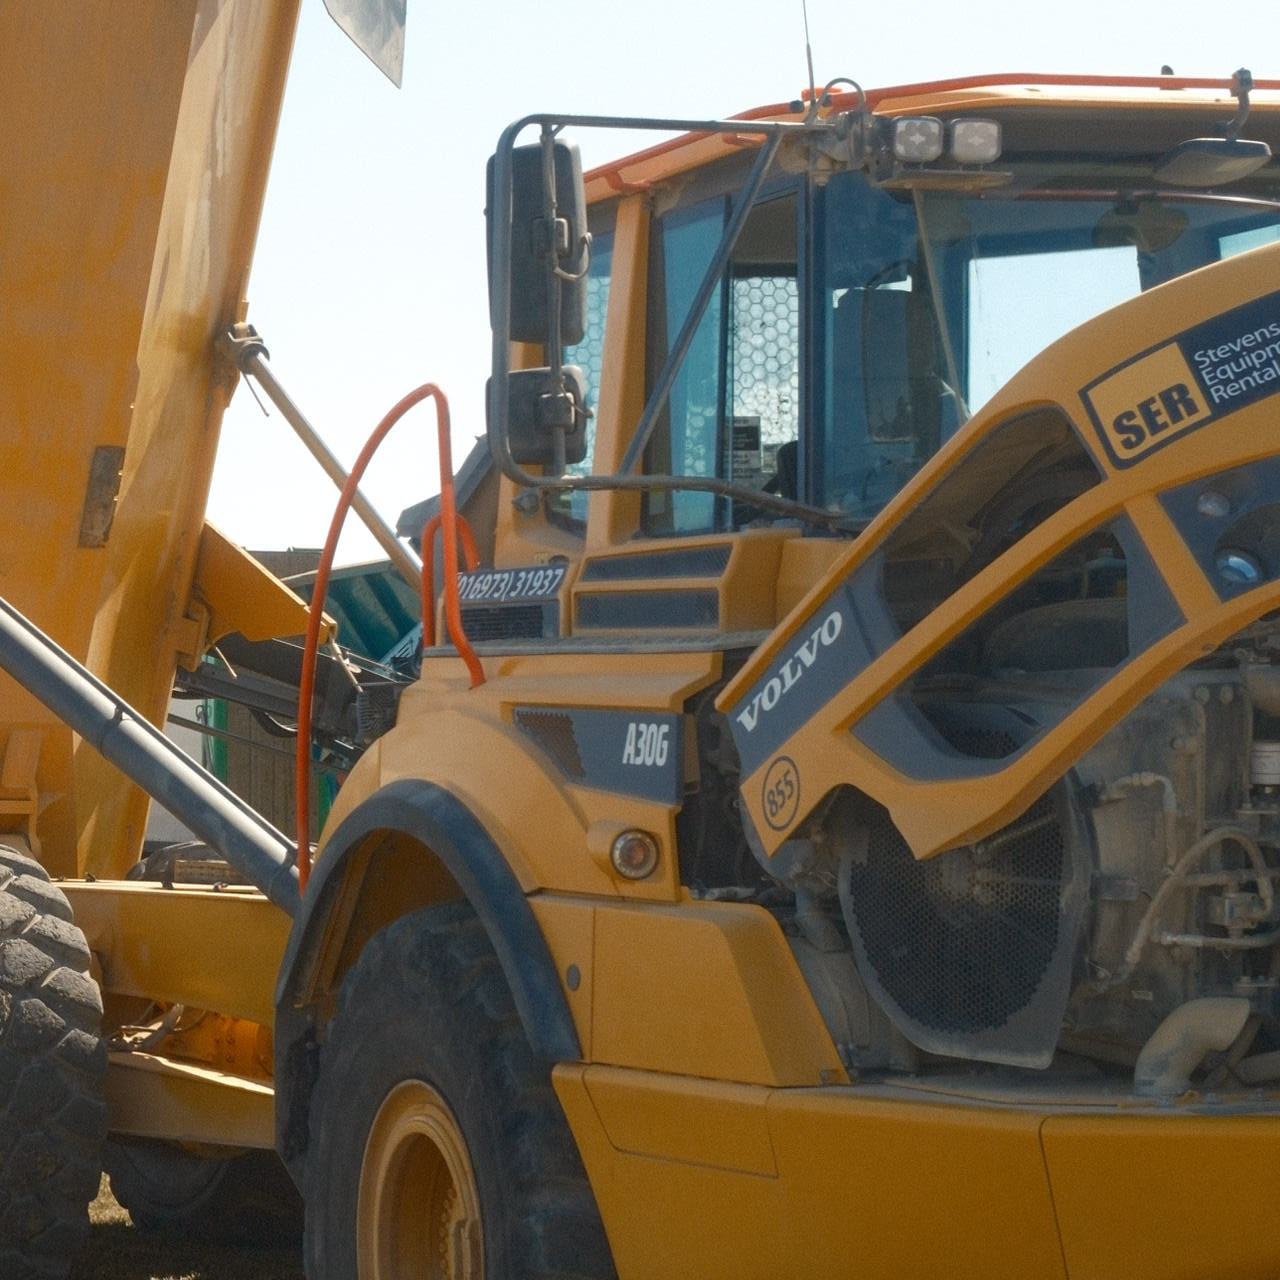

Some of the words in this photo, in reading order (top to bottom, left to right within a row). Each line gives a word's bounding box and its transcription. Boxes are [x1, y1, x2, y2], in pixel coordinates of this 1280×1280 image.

[1194, 323, 1280, 369] Stevens
[1210, 359, 1280, 404] Rental
[1112, 382, 1200, 451] SER
[509, 568, 564, 598] 31937
[736, 610, 843, 733] VOLVO
[622, 722, 670, 767] A30G
[766, 766, 794, 812] 855
